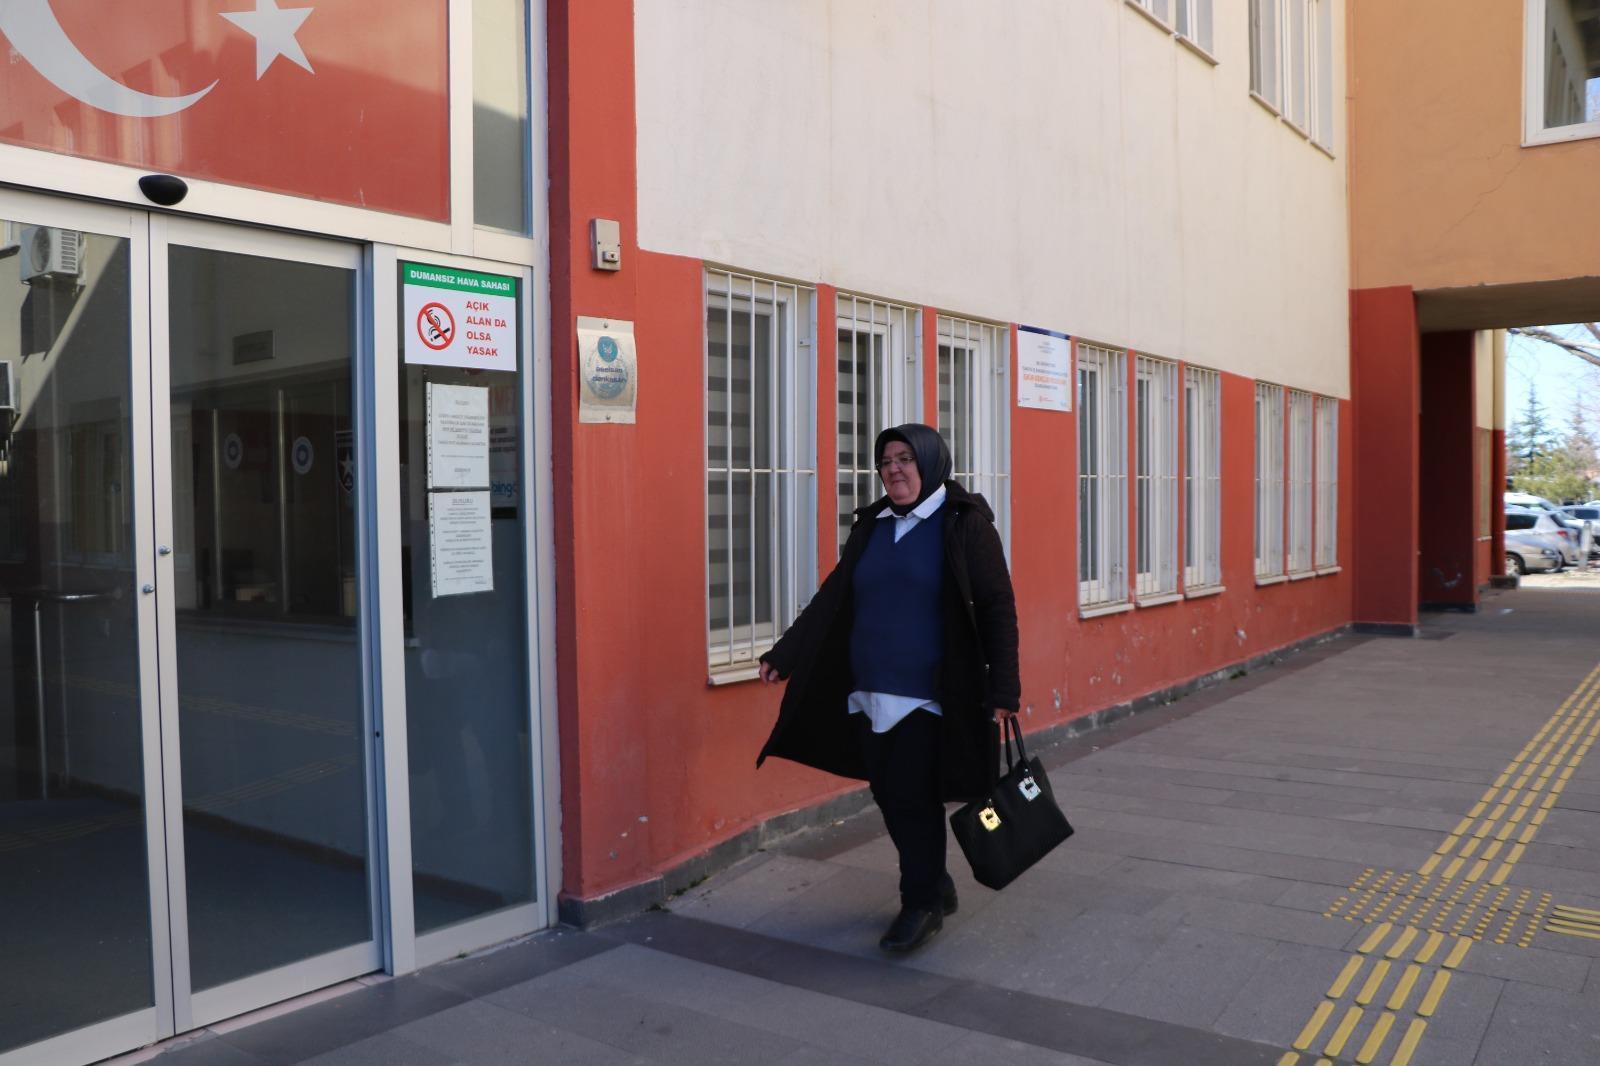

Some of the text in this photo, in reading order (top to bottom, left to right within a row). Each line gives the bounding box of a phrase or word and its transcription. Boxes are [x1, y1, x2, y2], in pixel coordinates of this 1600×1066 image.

[411, 271, 509, 291] DUMANSIZ HAVA SAHASI
[466, 301, 489, 311] AÇIK
[466, 316, 507, 327] ALAN DA
[466, 331, 491, 340] OLSA
[466, 346, 498, 356] YASAK
